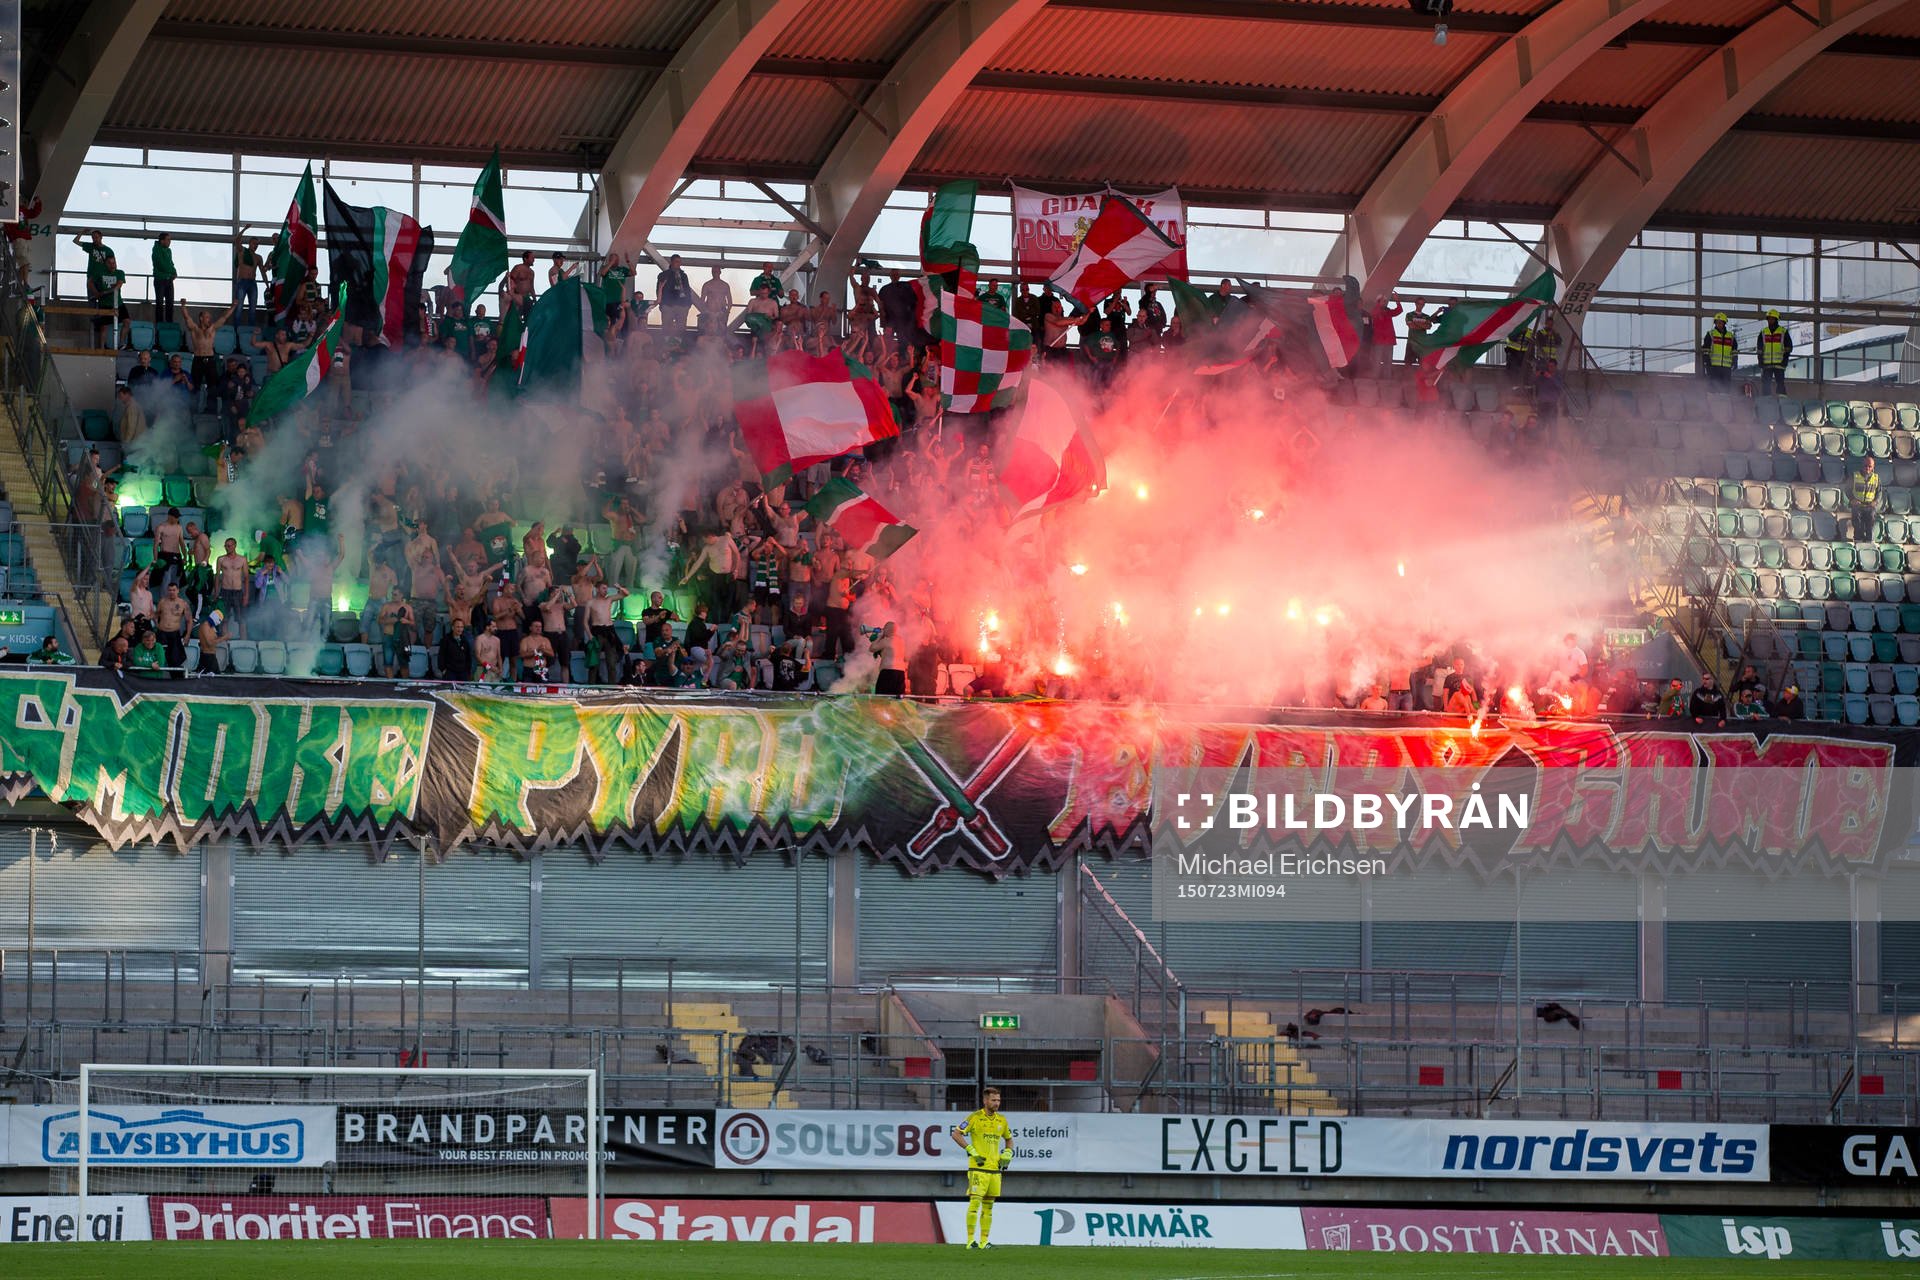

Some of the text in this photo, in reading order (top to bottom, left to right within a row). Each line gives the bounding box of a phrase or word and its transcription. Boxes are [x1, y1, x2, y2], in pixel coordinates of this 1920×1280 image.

[1041, 195, 1155, 216] GDAK
[1019, 218, 1183, 250] POLA
[9, 634, 38, 644] KIOSK
[57, 1131, 290, 1155] ÄLVSBYHUS
[345, 1114, 708, 1145] BRANDPARTNER
[1023, 1126, 1069, 1138] telefoni
[439, 1151, 615, 1161] YOUR BEST FRIEND IN PROMION
[1162, 1118, 1342, 1173] EXCEED
[1442, 1129, 1757, 1173] nordsvets
[163, 1203, 537, 1240] Prioritet Finans
[612, 1202, 875, 1243] Stavdal
[1085, 1208, 1212, 1238] PRIMÄR
[1721, 1218, 1793, 1259] isp
